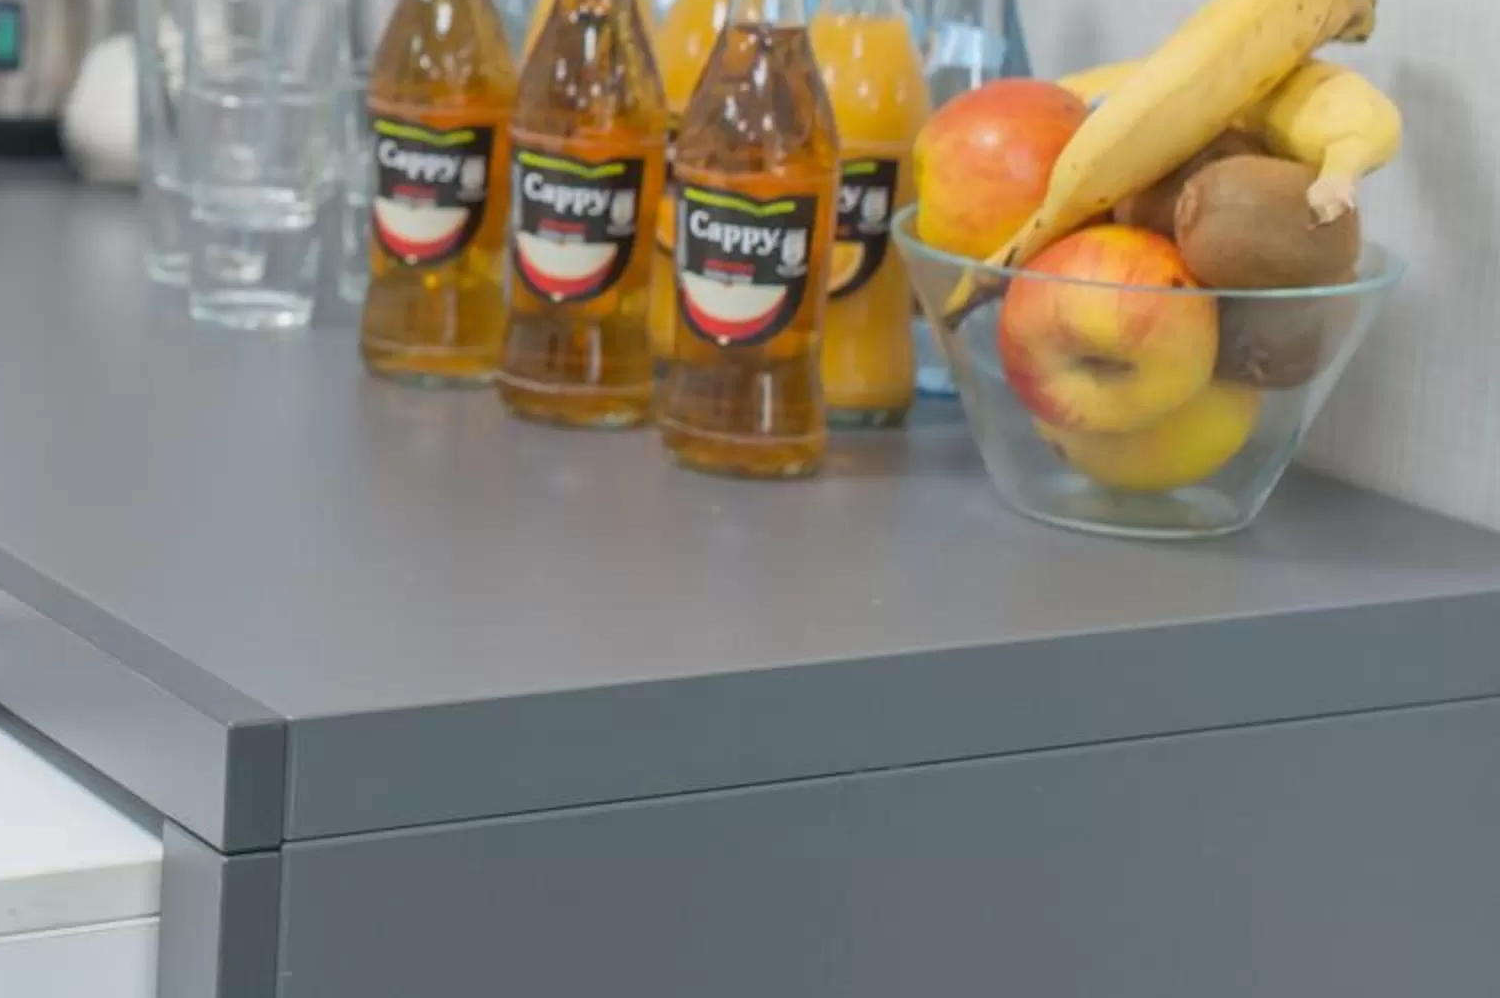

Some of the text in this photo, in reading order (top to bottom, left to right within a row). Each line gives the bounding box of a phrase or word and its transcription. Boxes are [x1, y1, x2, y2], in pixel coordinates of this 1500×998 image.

[378, 138, 458, 183] Cappy
[523, 171, 611, 217] Cappy
[689, 209, 781, 257] Cappy
